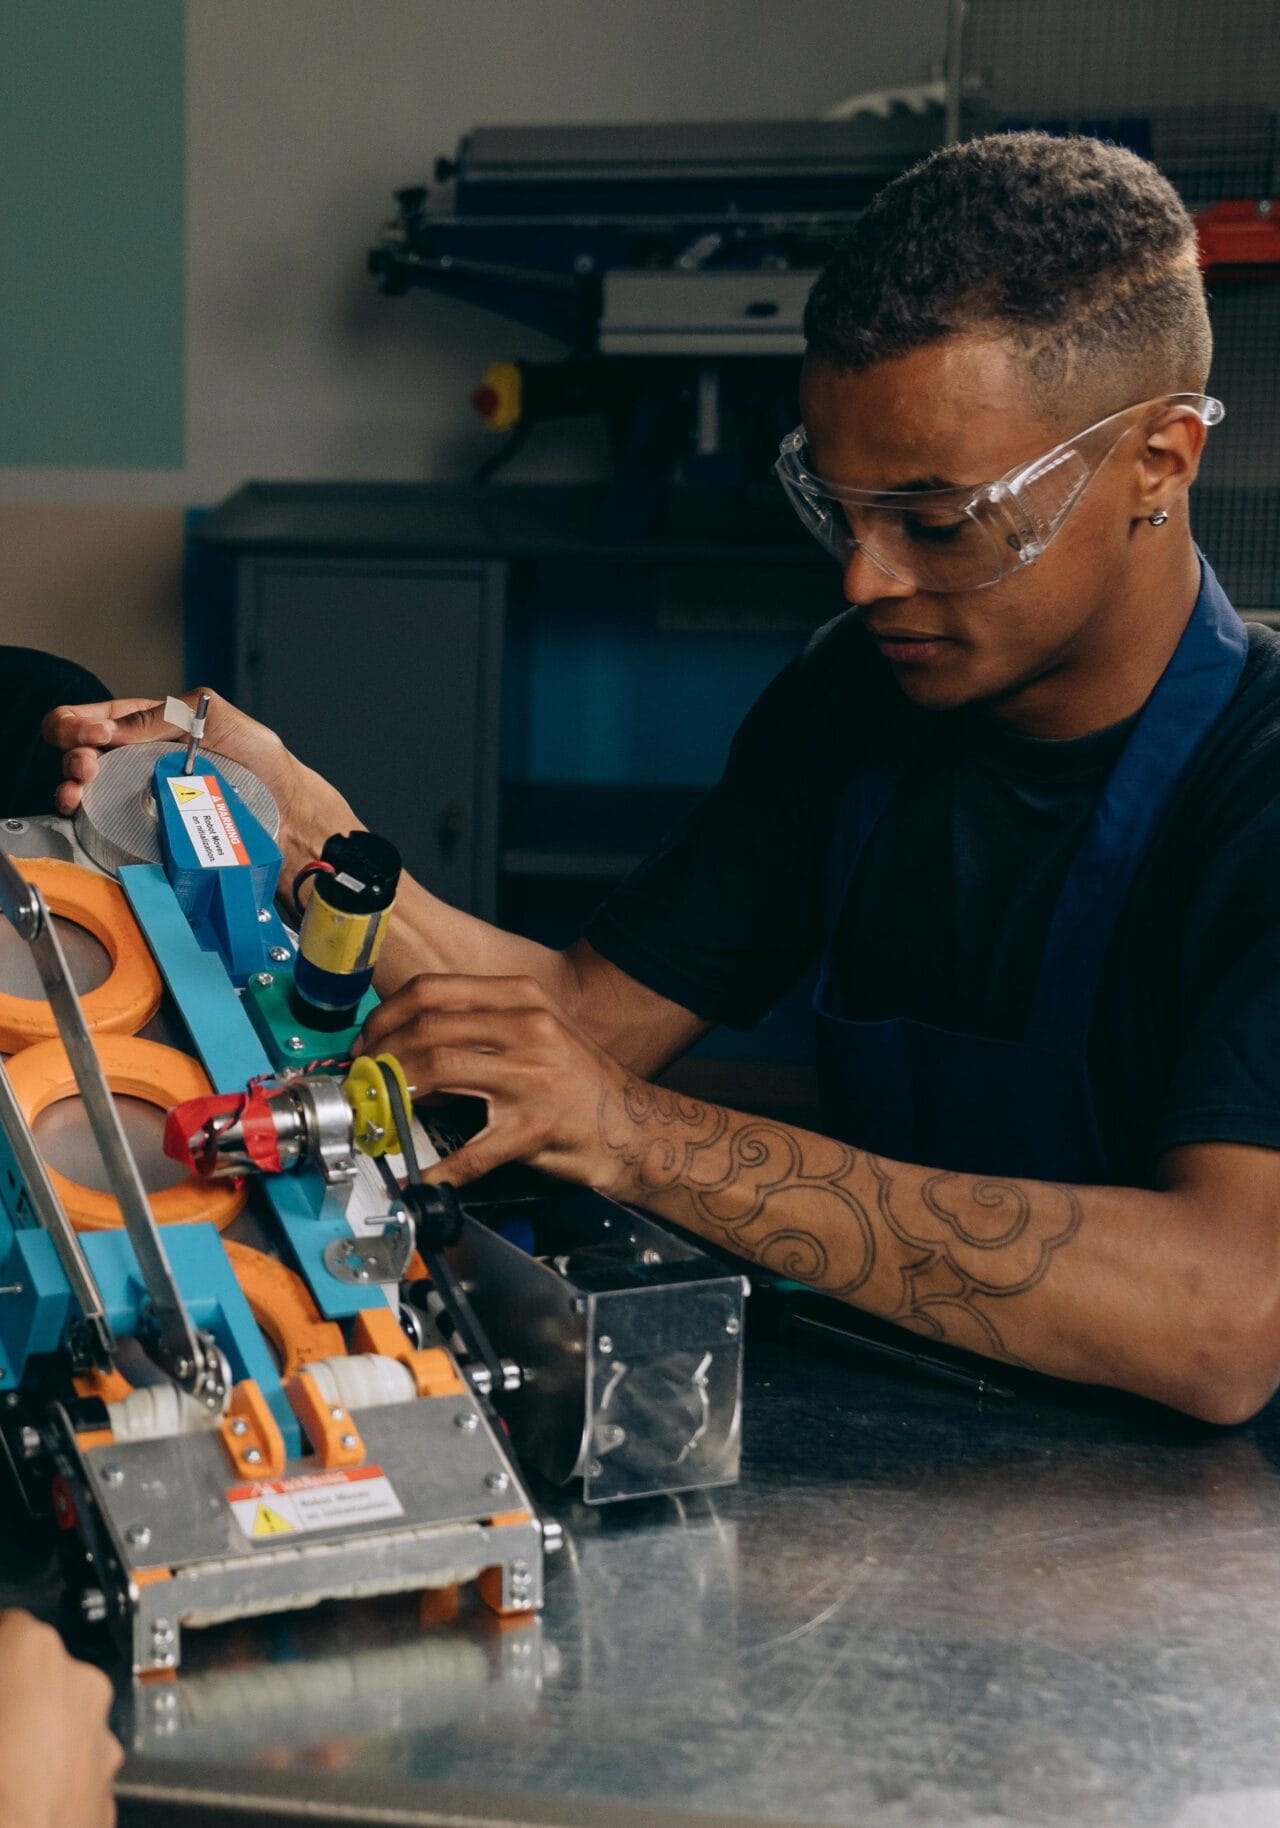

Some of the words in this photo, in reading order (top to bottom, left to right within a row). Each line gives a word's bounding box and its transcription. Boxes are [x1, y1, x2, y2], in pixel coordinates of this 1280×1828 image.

[192, 816, 200, 824] on
[203, 815, 216, 834] Robot
[212, 836, 224, 855] Moves
[216, 803, 240, 845] WARNING
